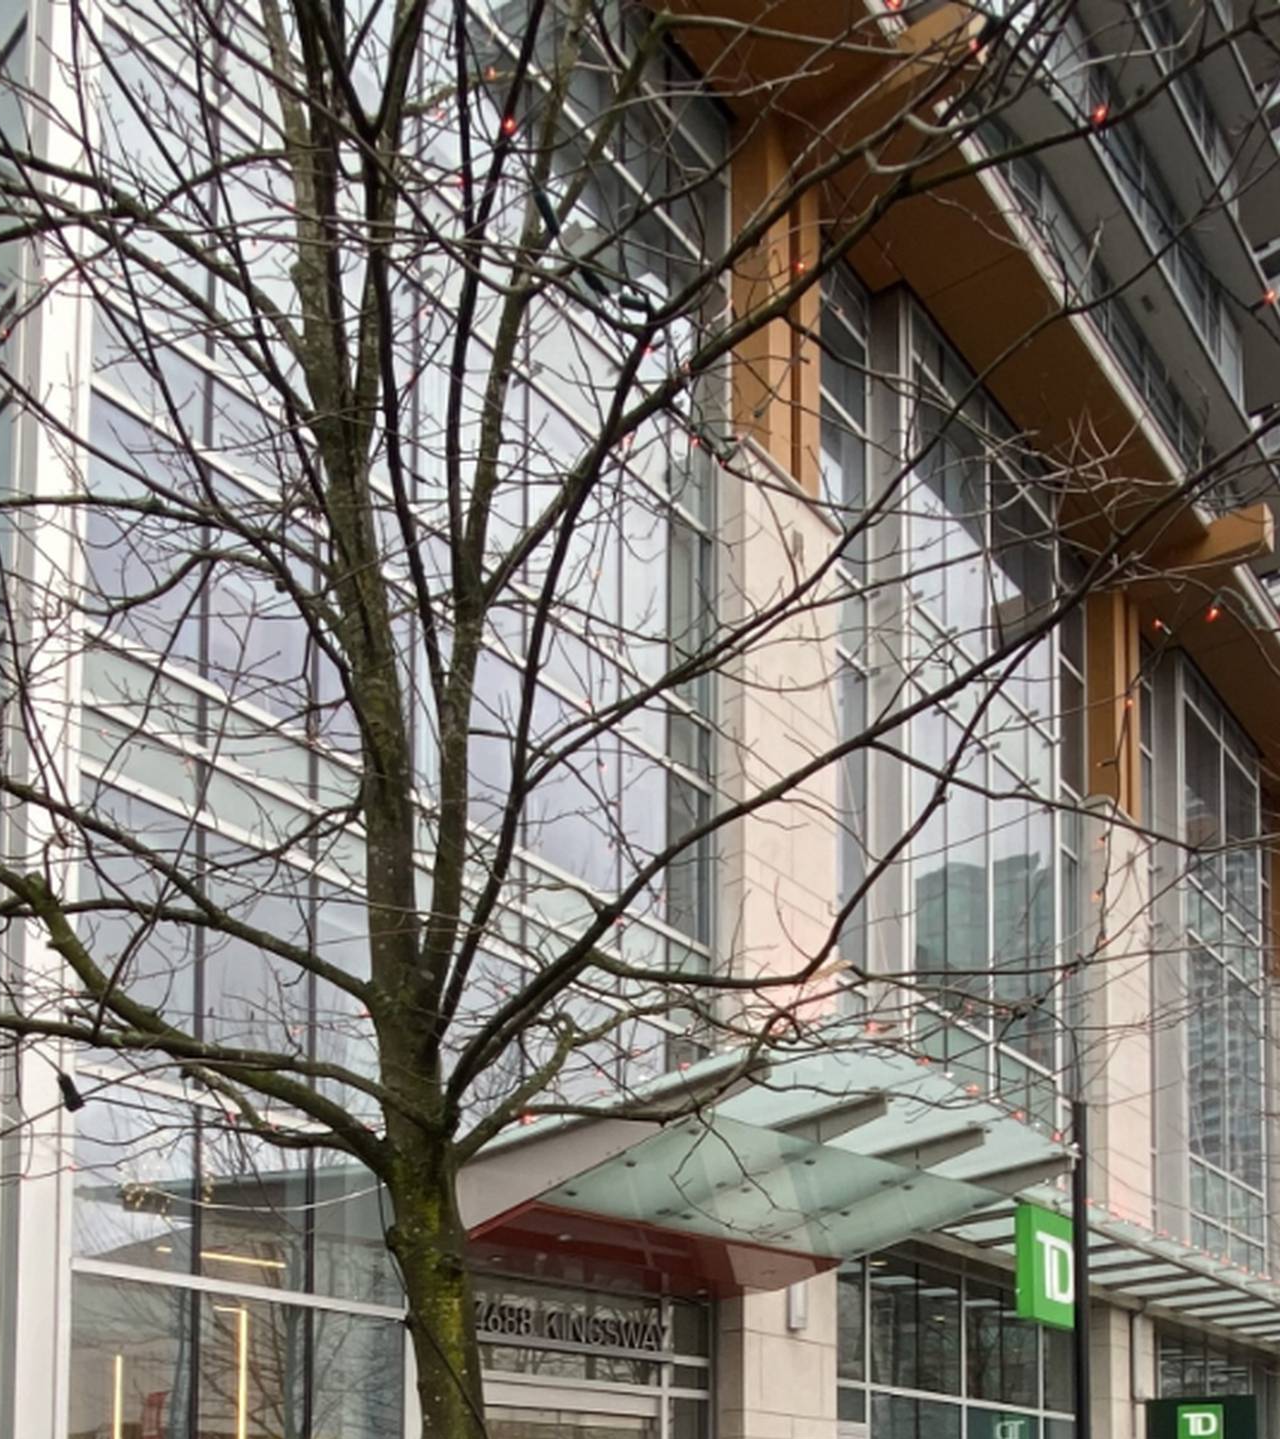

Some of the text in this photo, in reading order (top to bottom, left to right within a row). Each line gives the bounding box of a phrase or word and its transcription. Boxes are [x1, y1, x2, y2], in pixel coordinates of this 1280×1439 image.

[1035, 1231, 1074, 1304] TD
[544, 1310, 671, 1352] KINGSWAY
[1182, 1412, 1217, 1436] TD
